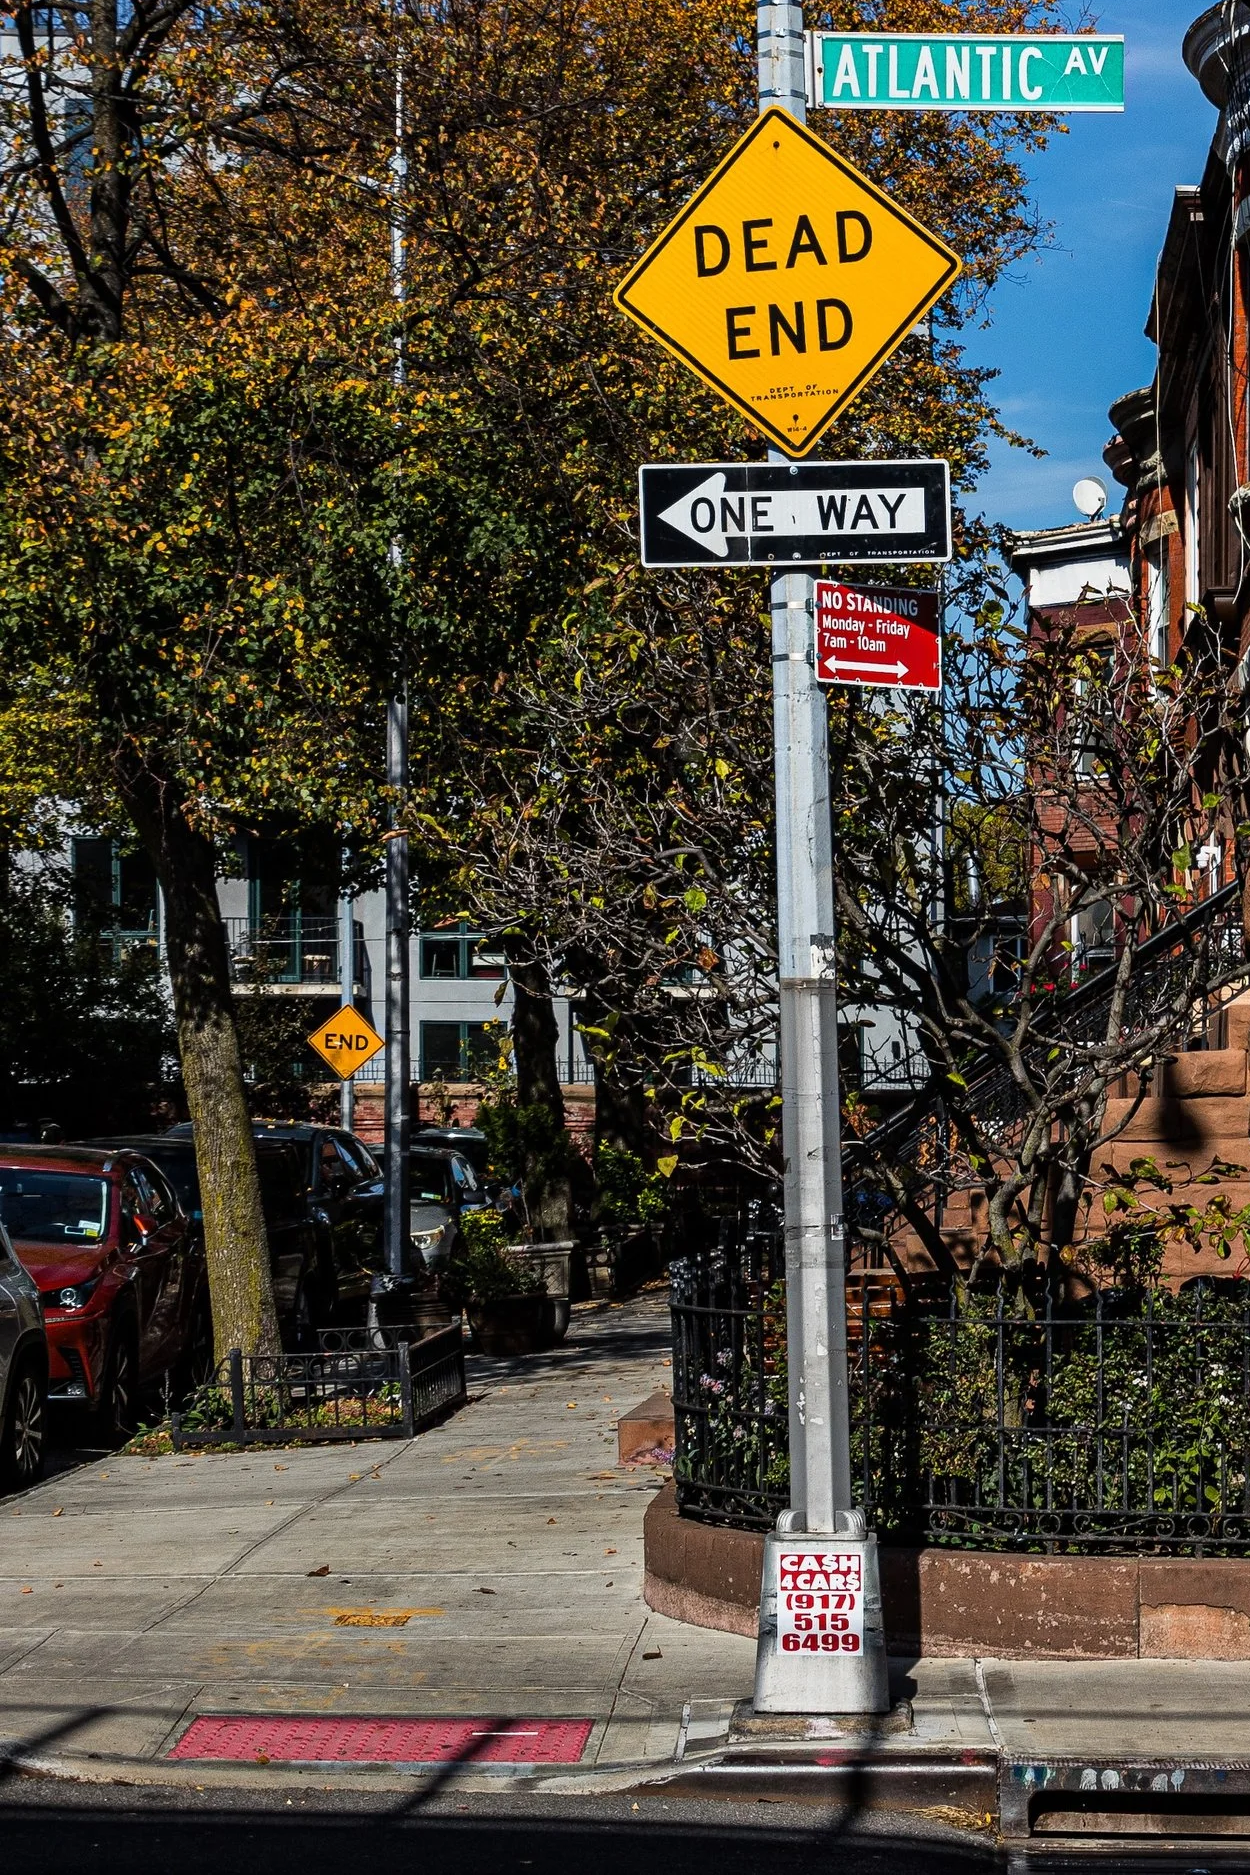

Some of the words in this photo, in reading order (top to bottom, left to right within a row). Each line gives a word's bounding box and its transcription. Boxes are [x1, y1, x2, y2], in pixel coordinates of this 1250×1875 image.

[832, 43, 1043, 101] ATLANTIC
[1064, 45, 1110, 76] AV
[694, 210, 873, 278] DEAD
[725, 298, 853, 360] END
[750, 388, 839, 402] TRANSPORTATION
[769, 385, 795, 394] DEPT
[805, 383, 818, 391] OF
[690, 496, 774, 533] ONE
[817, 493, 907, 531] WAY
[821, 590, 843, 610] NO
[846, 592, 918, 617] STANDING
[822, 614, 866, 635] Monday
[876, 619, 911, 639] Friday
[823, 633, 847, 648] 7am
[857, 636, 886, 652] 10am
[325, 1033, 369, 1051] END
[786, 1593, 856, 1611] (917)
[794, 1613, 849, 1631] 515
[782, 1633, 860, 1652] 6499
